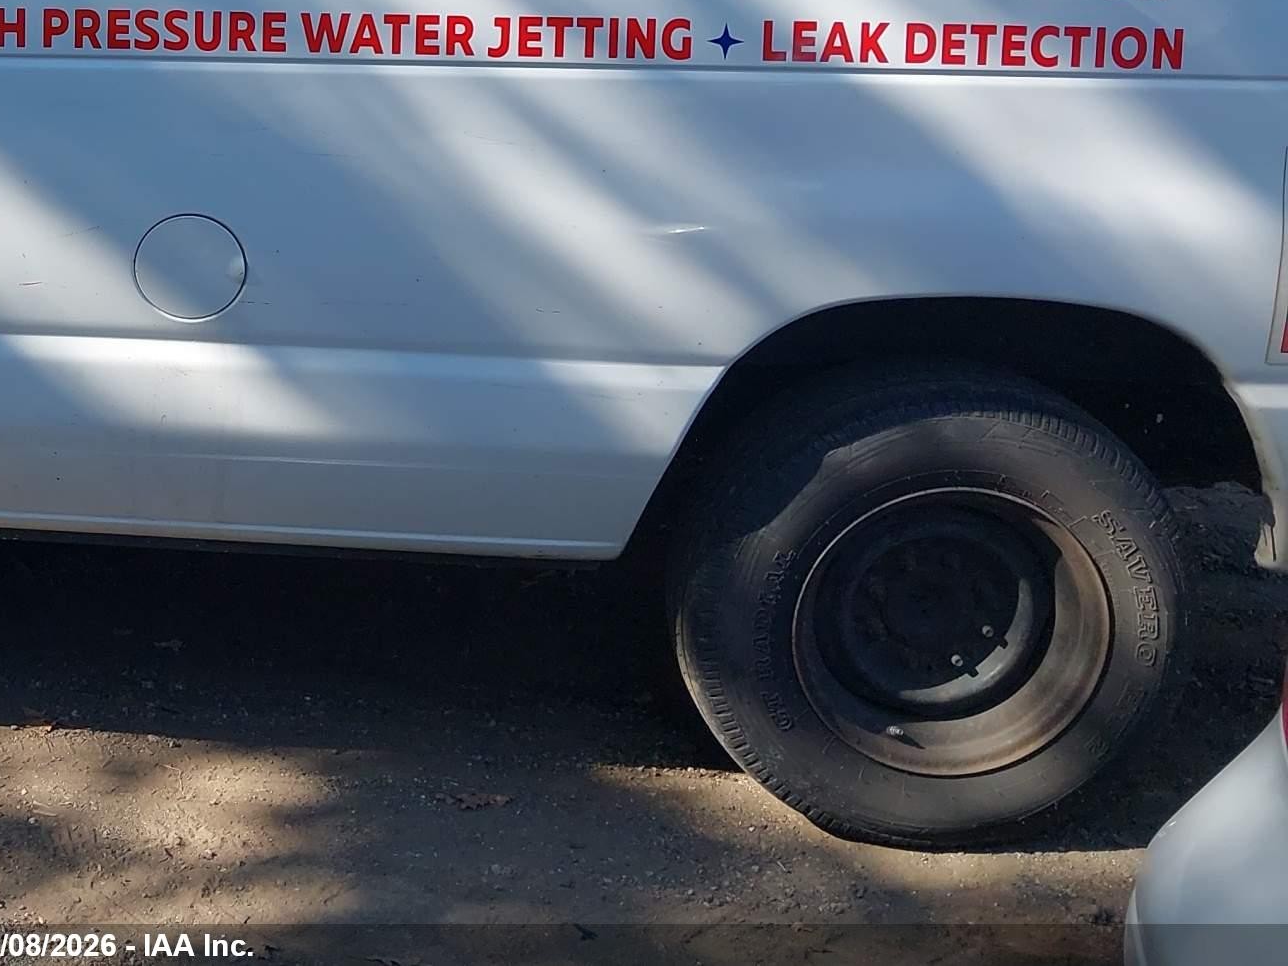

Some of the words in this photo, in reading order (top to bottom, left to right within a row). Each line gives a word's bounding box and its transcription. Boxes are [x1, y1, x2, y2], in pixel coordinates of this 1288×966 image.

[43, 10, 287, 53] PRESSURE
[301, 13, 476, 59] WATER
[487, 16, 693, 61] JETTING
[761, 20, 890, 64] LEAK
[905, 22, 1185, 70] DETECTION
[1091, 508, 1161, 668] SAVERO
